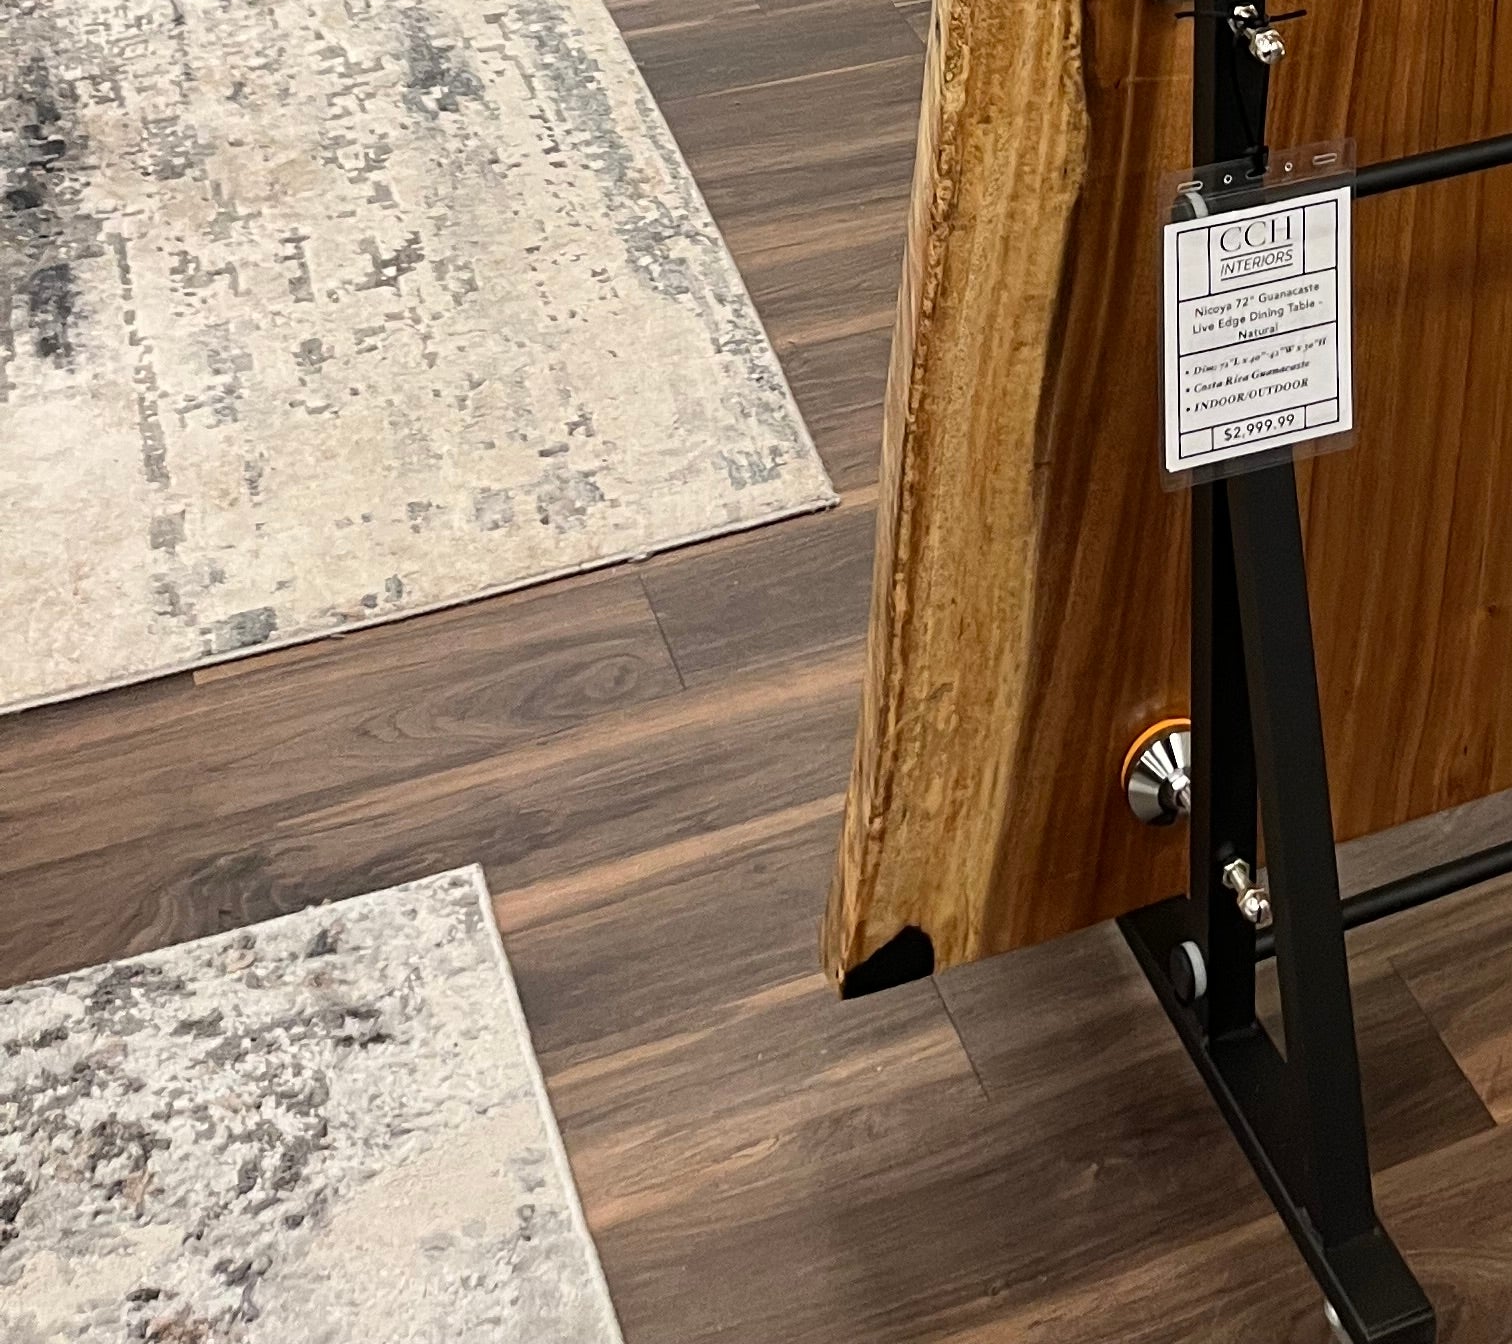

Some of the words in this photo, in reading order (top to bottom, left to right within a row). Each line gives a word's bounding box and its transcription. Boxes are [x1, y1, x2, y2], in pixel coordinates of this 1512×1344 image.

[1220, 215, 1292, 253] CCH
[1219, 249, 1294, 276] INTERIORS
[1192, 324, 1215, 335] Live
[1218, 316, 1246, 329] Edge
[1249, 307, 1285, 322] Dining
[1288, 300, 1315, 313] Table
[1194, 303, 1232, 319] Nicoya
[1235, 295, 1255, 309] 72"
[1258, 283, 1320, 304] Guanacaste
[1238, 322, 1279, 340] Natural
[1193, 380, 1223, 393] Costa
[1225, 373, 1249, 387] Rica
[1251, 360, 1311, 380] Guanacaste
[1193, 378, 1309, 413] INDOOR/OUTDOOR
[1223, 413, 1295, 442] $2,999.99
